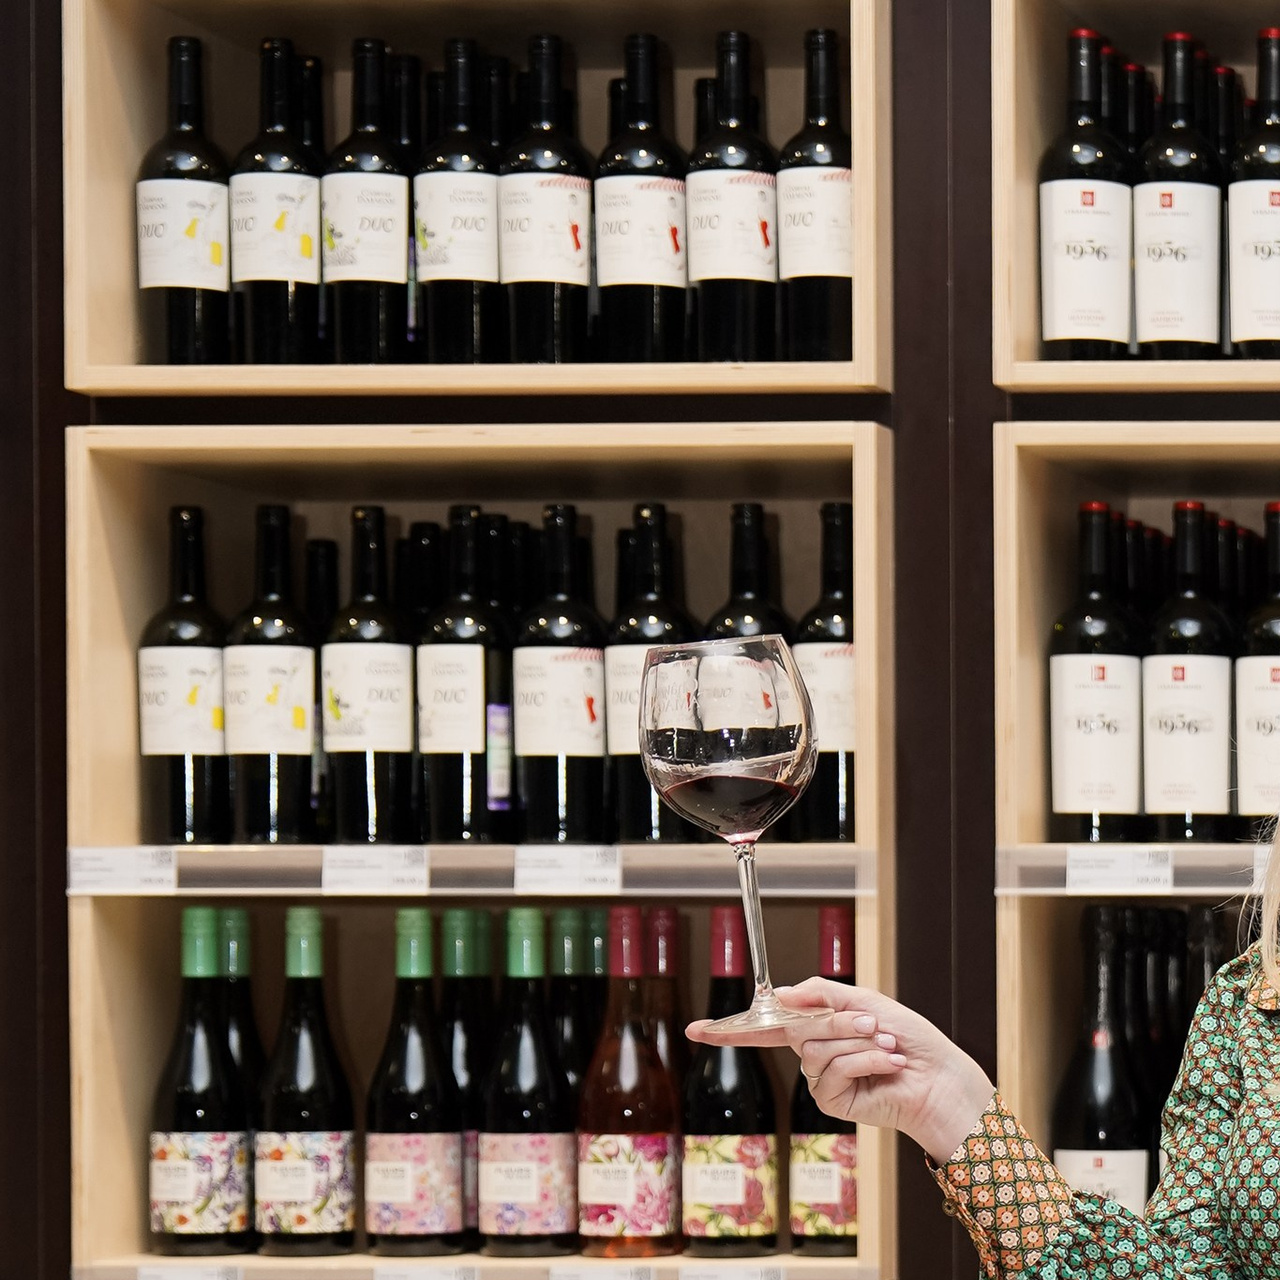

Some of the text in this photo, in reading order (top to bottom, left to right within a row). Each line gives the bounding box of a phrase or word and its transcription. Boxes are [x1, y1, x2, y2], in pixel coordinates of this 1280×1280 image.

[359, 216, 395, 232] DUO
[452, 217, 488, 232] DUO
[503, 217, 531, 232] DUO
[601, 220, 630, 235] DUO
[691, 214, 720, 230] DUO
[784, 211, 813, 228] DUO
[1064, 239, 1108, 261] 1956
[1146, 241, 1186, 262] 1956
[1076, 713, 1120, 735] 1956
[1157, 713, 1199, 735] 1956
